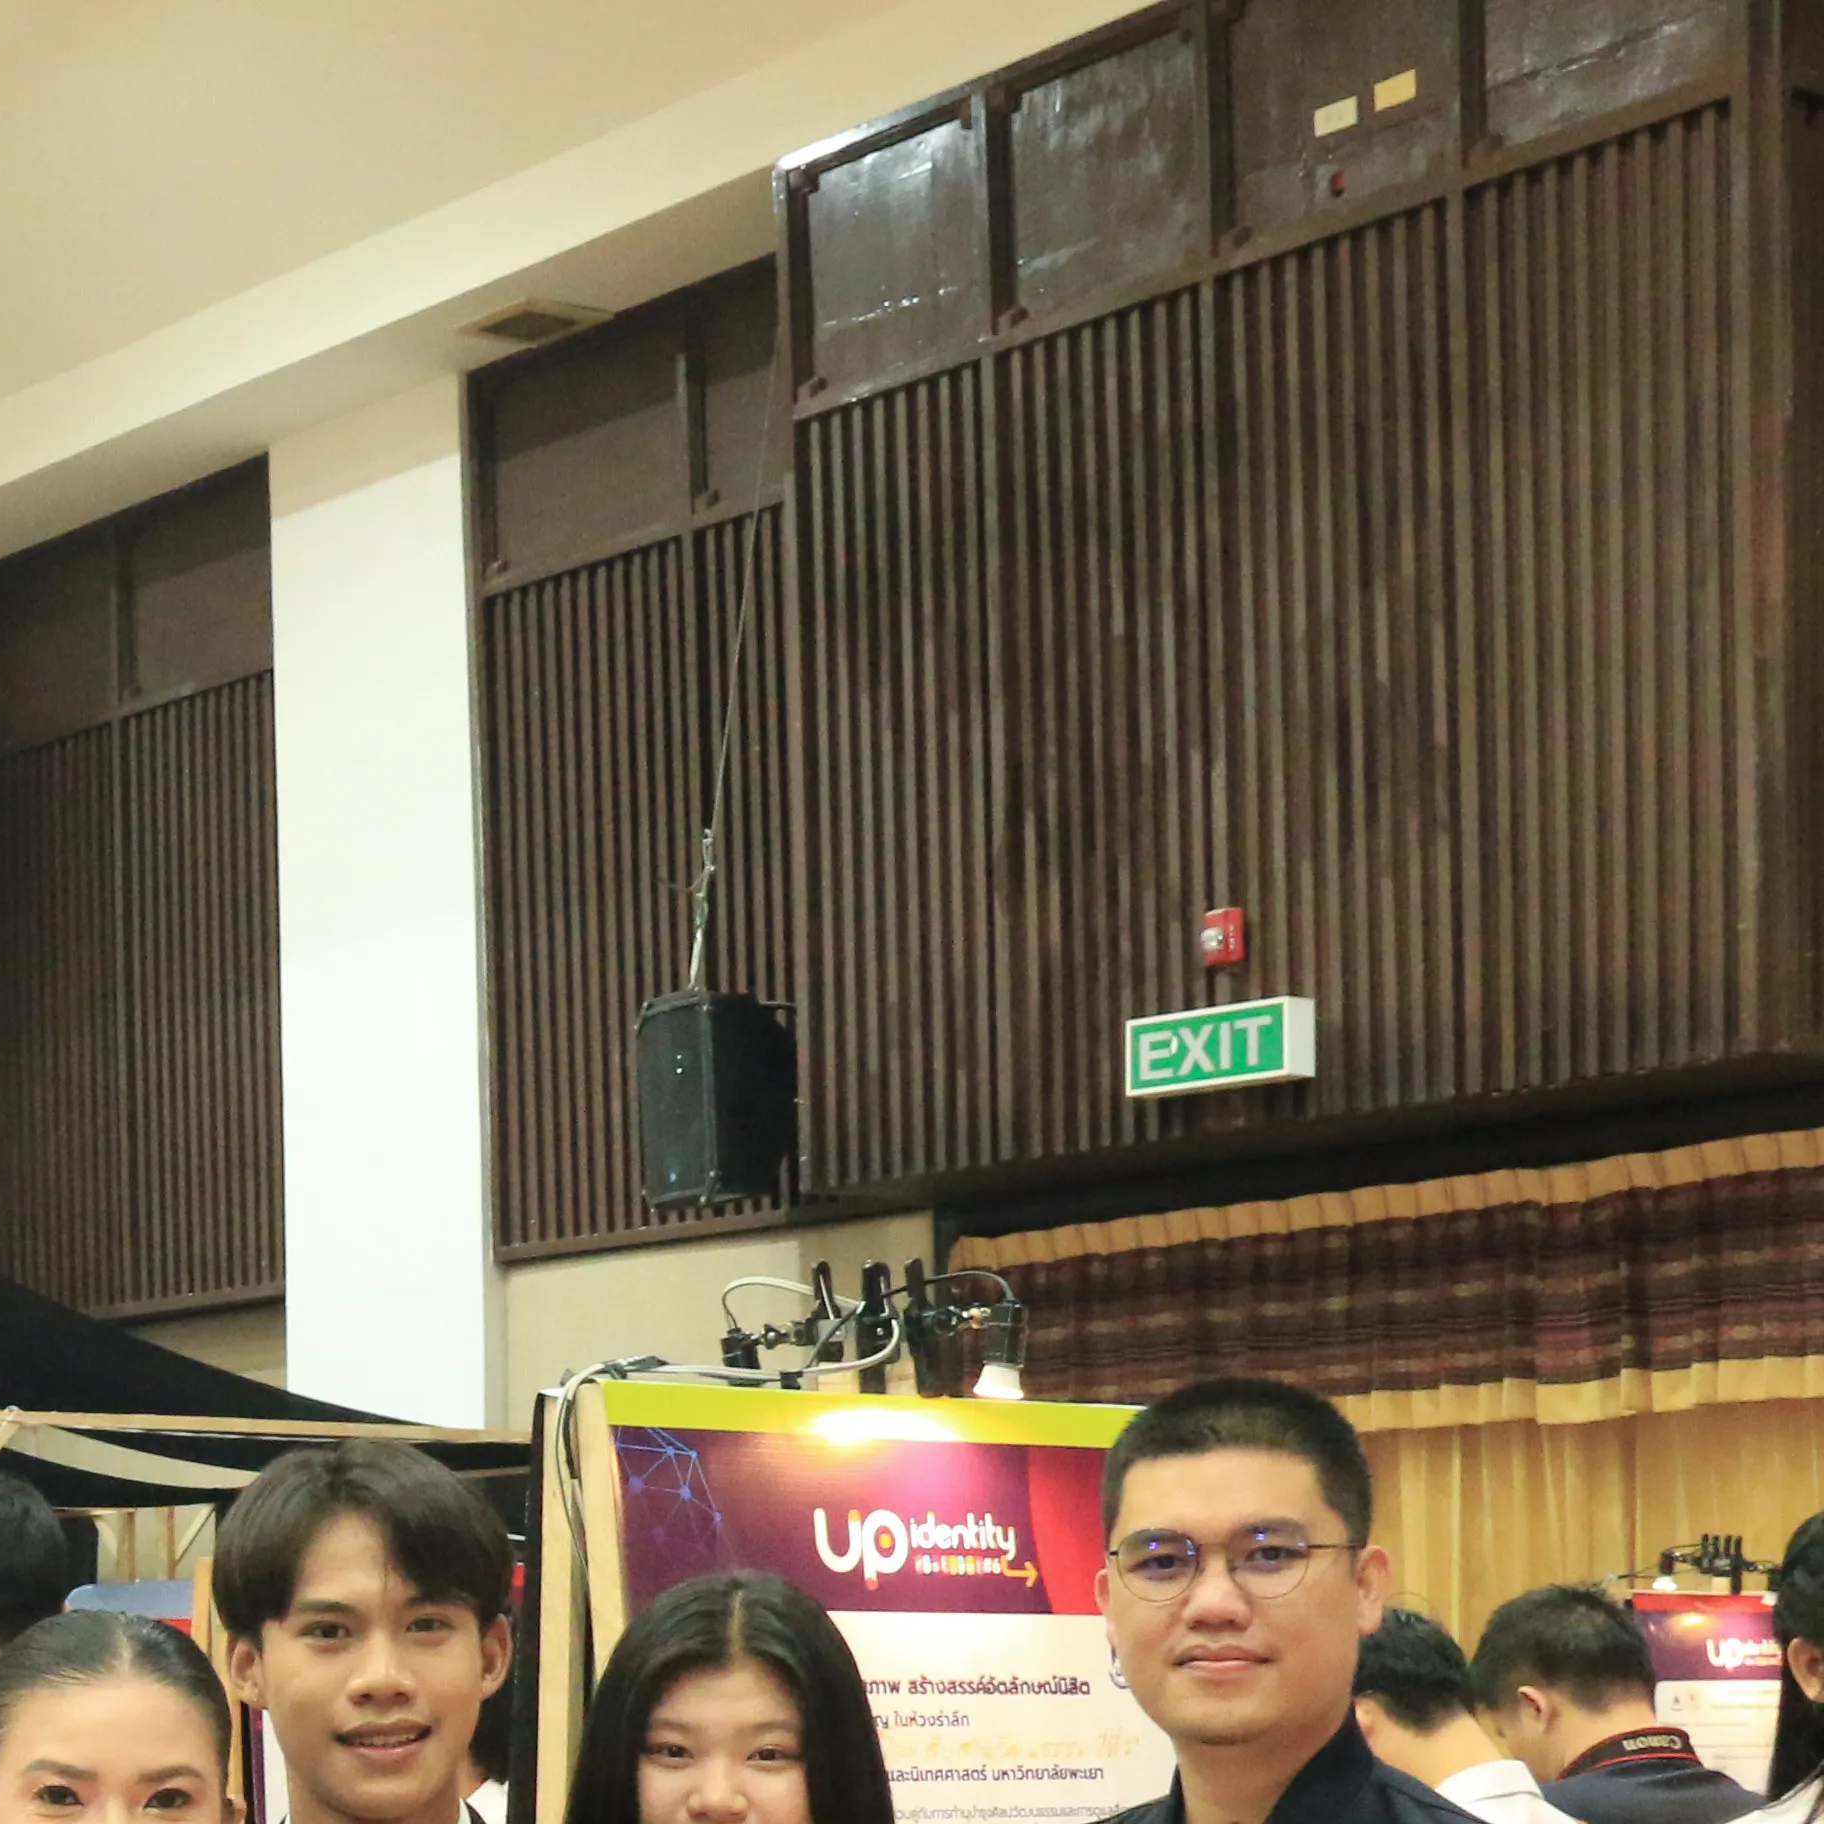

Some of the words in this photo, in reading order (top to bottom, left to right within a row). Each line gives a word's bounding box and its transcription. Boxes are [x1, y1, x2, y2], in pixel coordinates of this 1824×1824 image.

[1138, 1015, 1273, 1081] EXIT
[909, 1511, 1017, 1561] identity
[908, 1674, 1091, 1696] สร้างสรรค์อัตลักษณ์นิสิต
[992, 1764, 1104, 1782] มหาวิทยาลัยพะเยา
